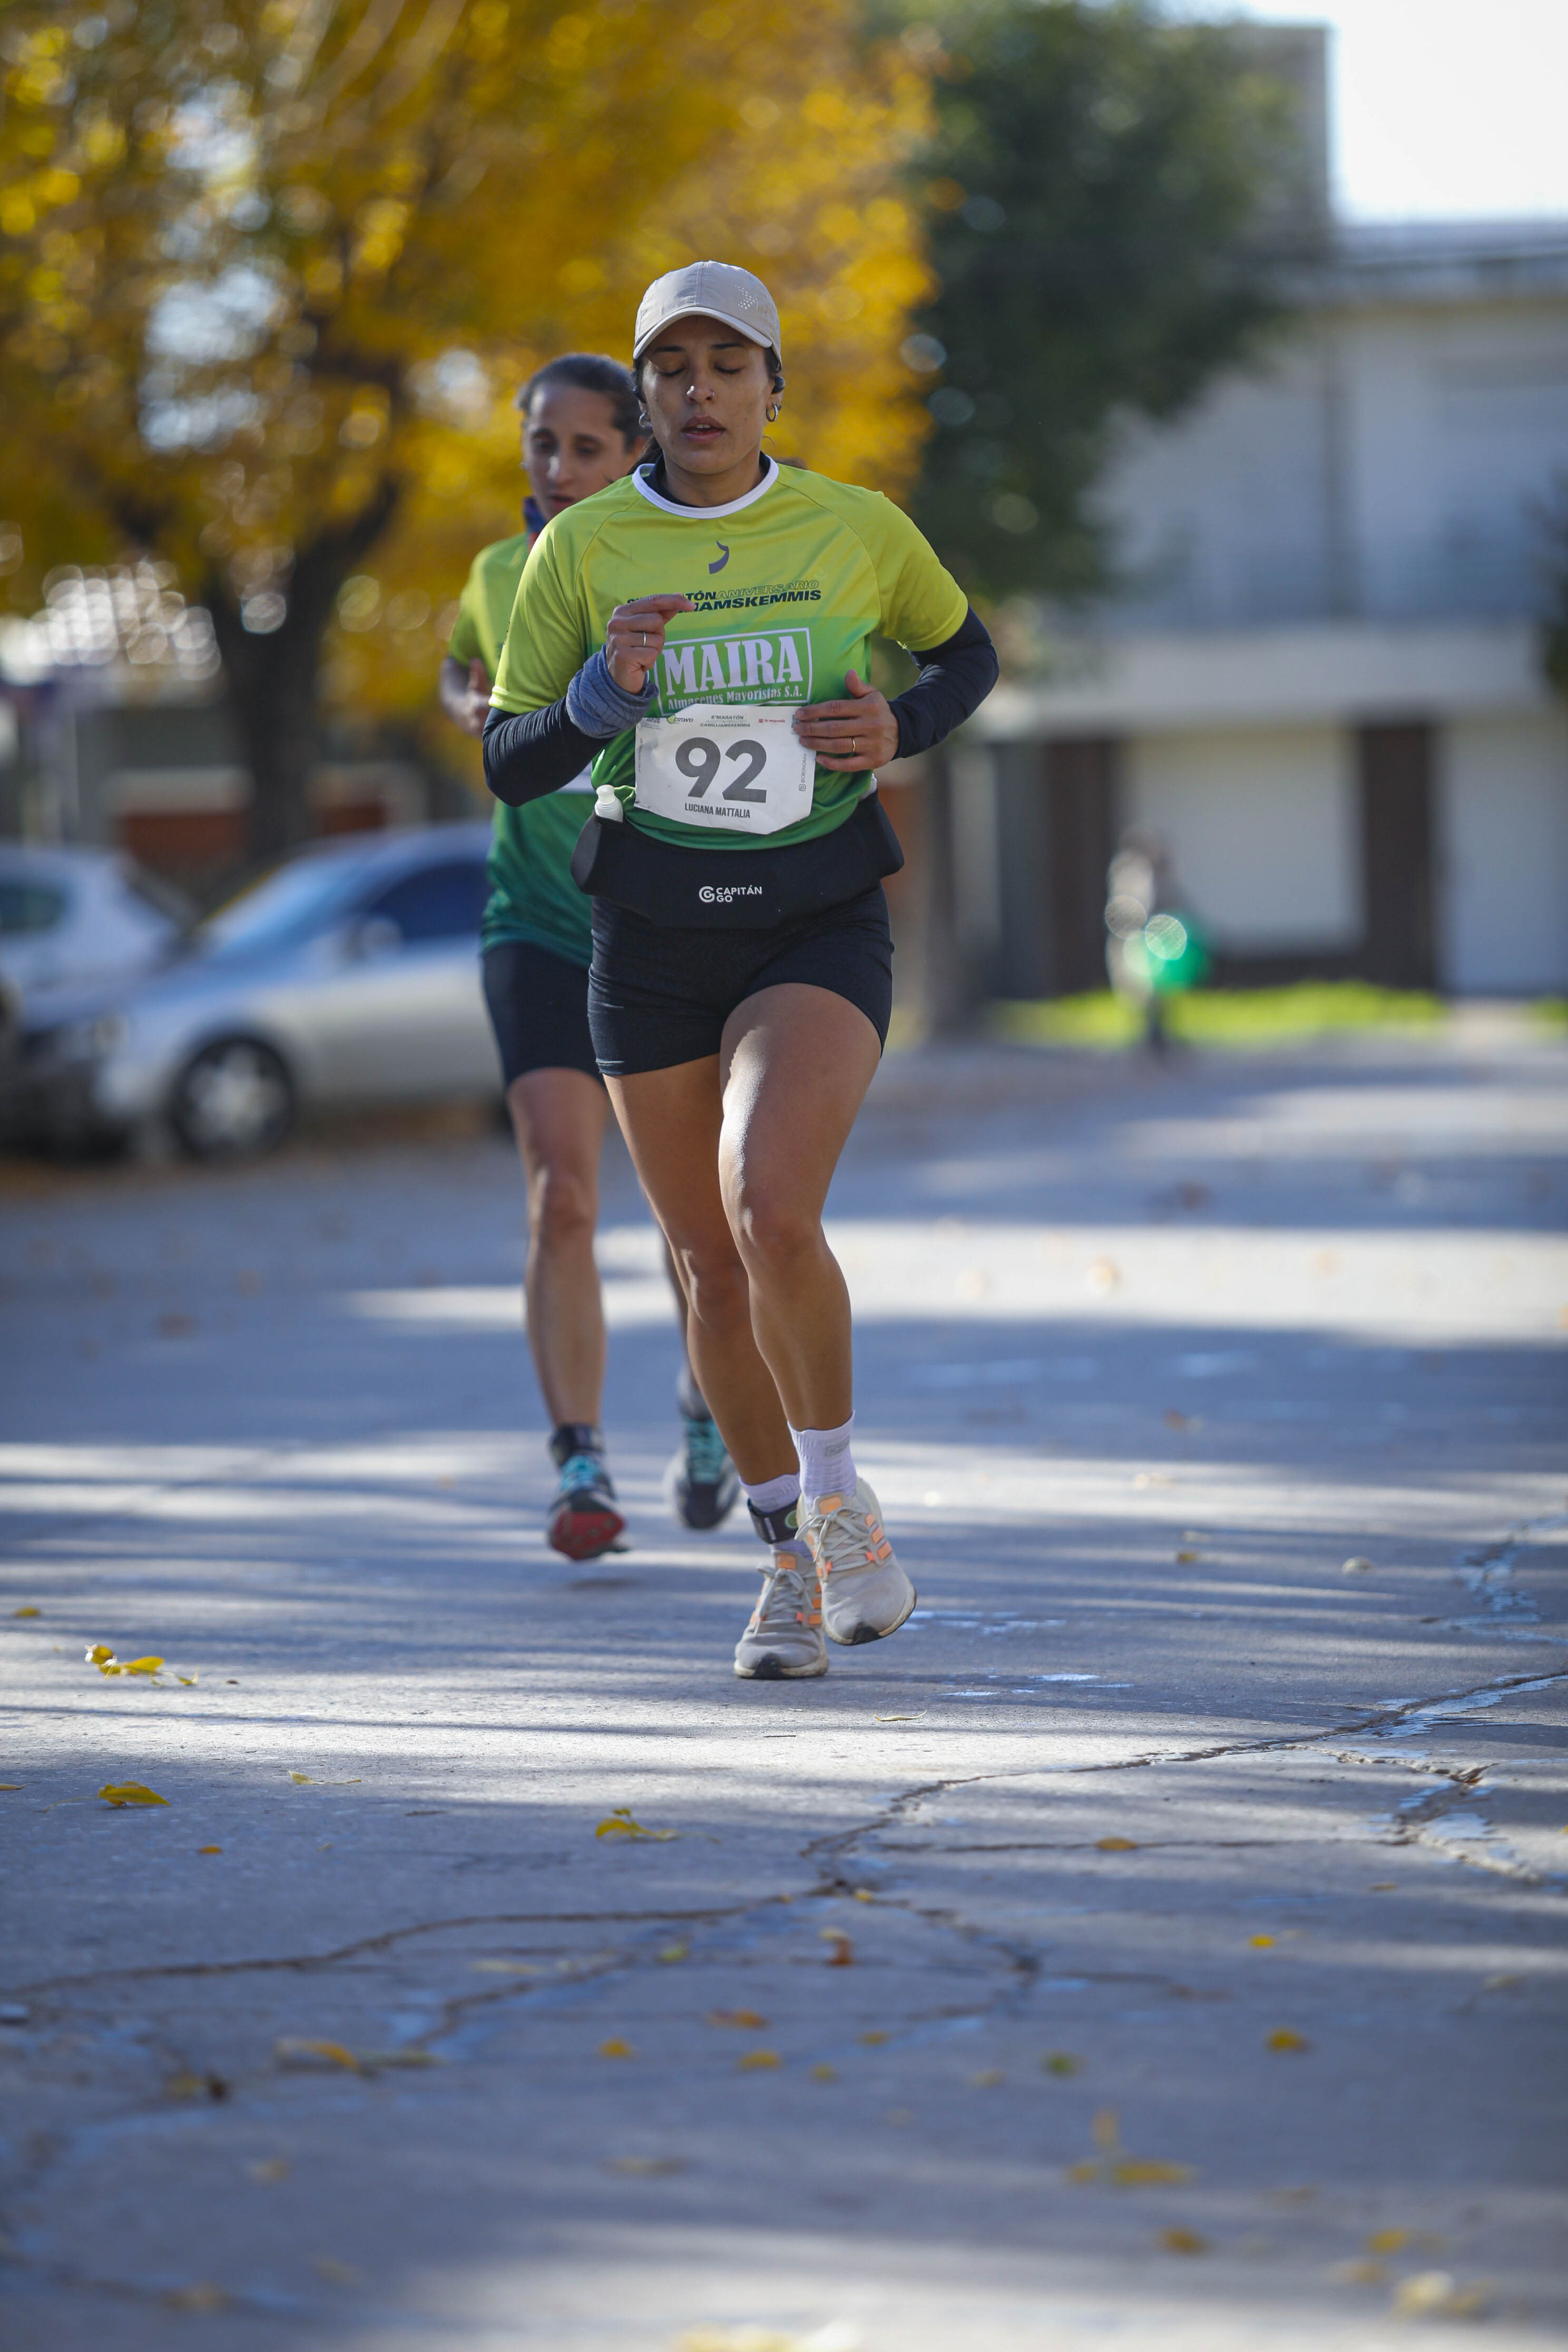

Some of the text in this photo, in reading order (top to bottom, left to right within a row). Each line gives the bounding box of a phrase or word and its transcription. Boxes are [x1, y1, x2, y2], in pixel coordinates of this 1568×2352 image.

[662, 636, 803, 695] MAIRA
[668, 685, 802, 710] Almacenes Mayoristas S.A.
[675, 737, 767, 803] 92
[684, 802, 750, 818] LUCIANA MATTALIA
[716, 885, 762, 895] CAPITÁN
